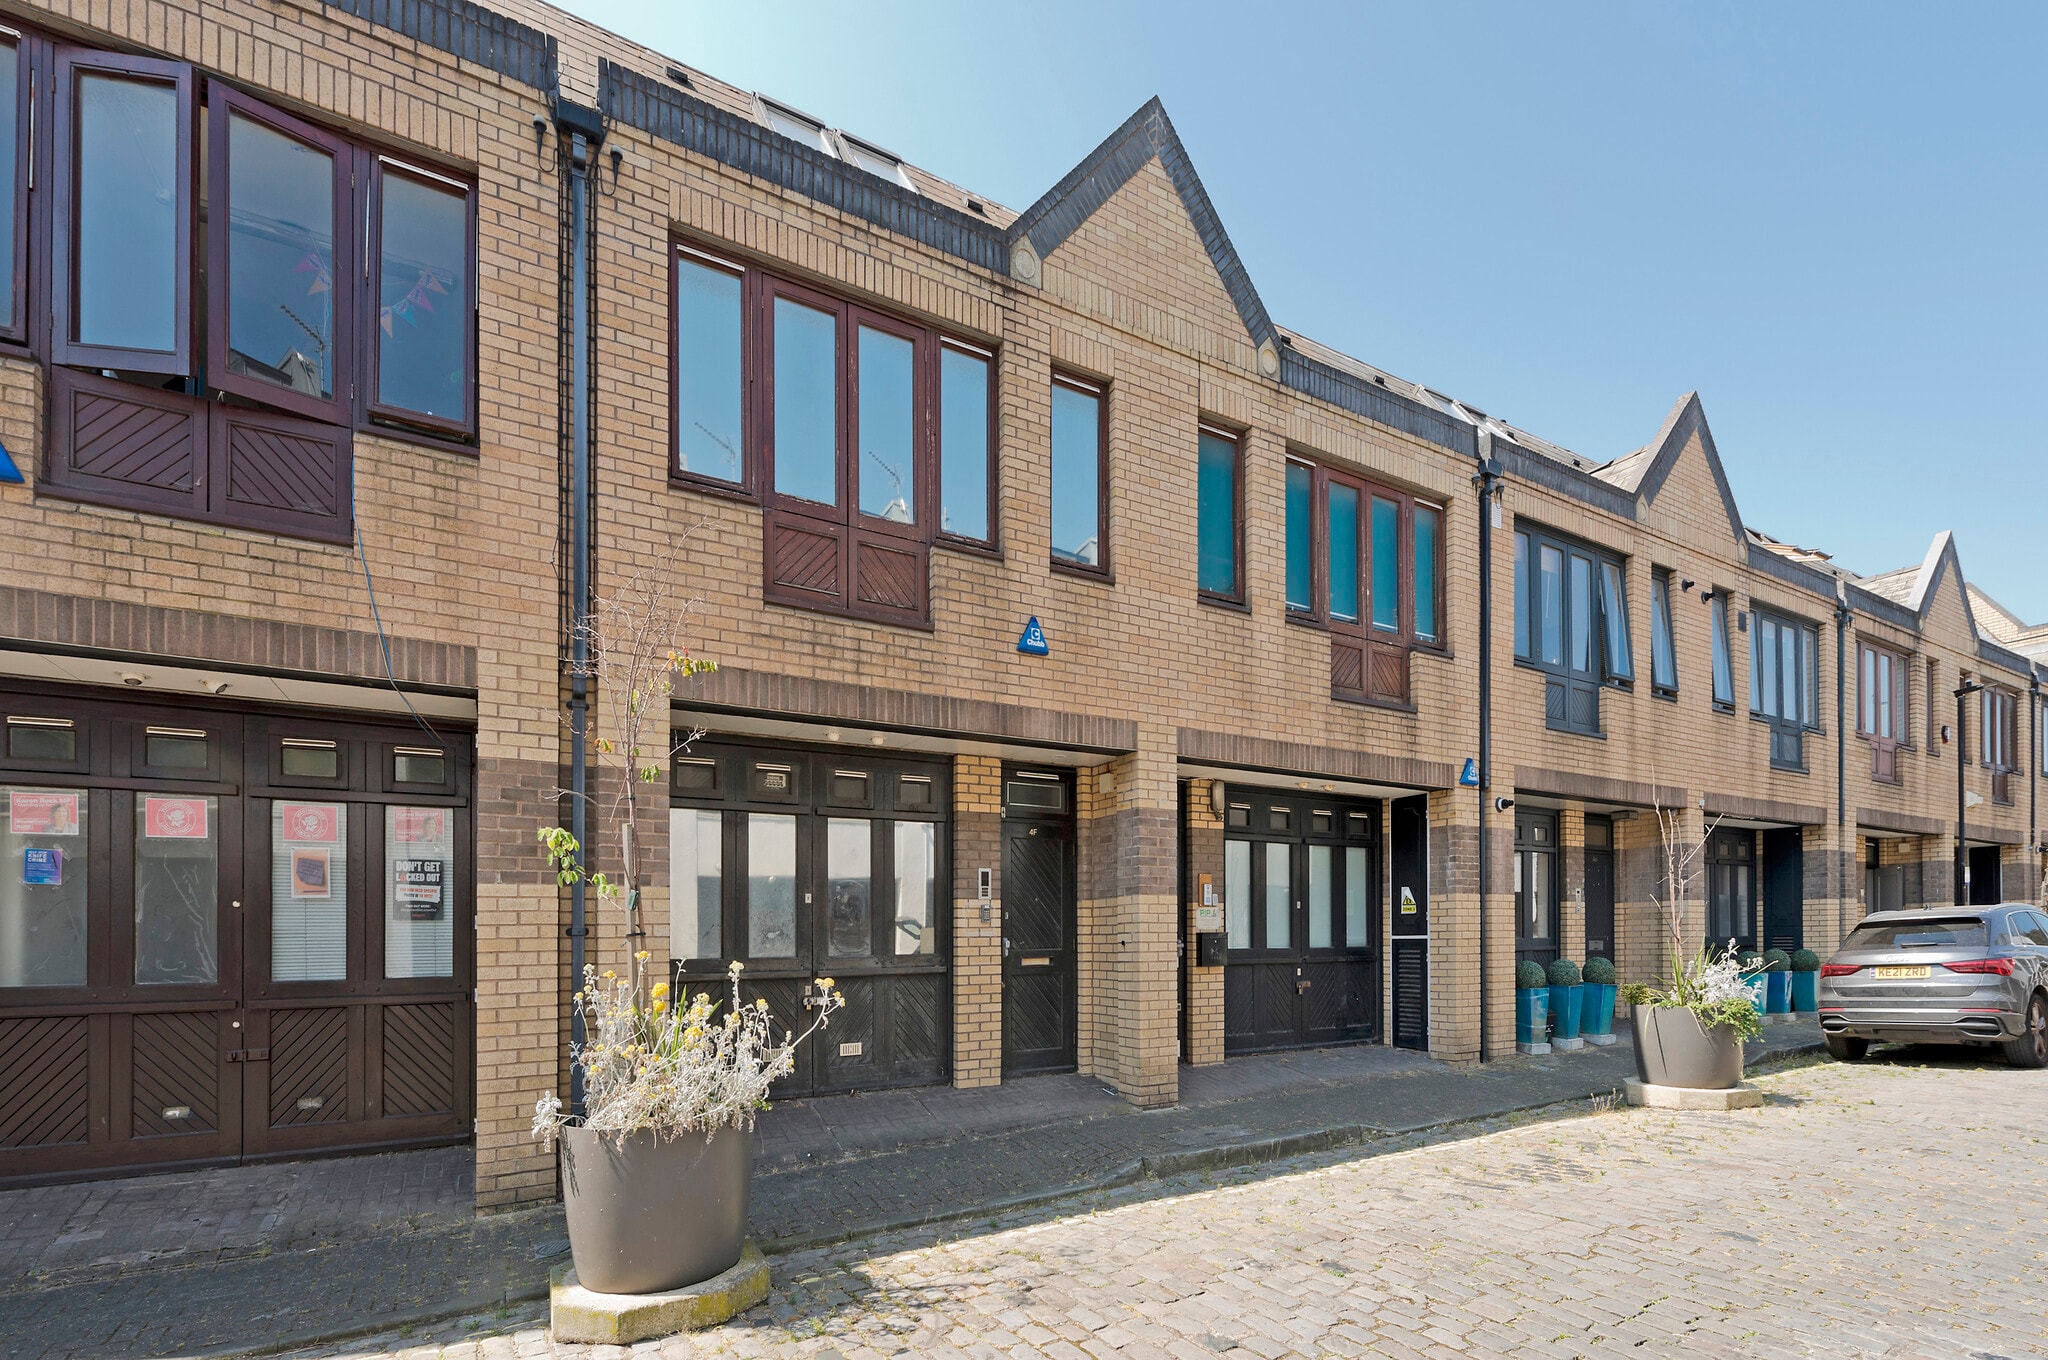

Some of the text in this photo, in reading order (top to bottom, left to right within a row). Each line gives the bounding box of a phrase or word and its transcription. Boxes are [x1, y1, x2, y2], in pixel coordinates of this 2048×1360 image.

[395, 861, 441, 872] DON'T GET
[426, 873, 441, 882] OUT
[1878, 967, 1926, 976] KE21 ZRD
